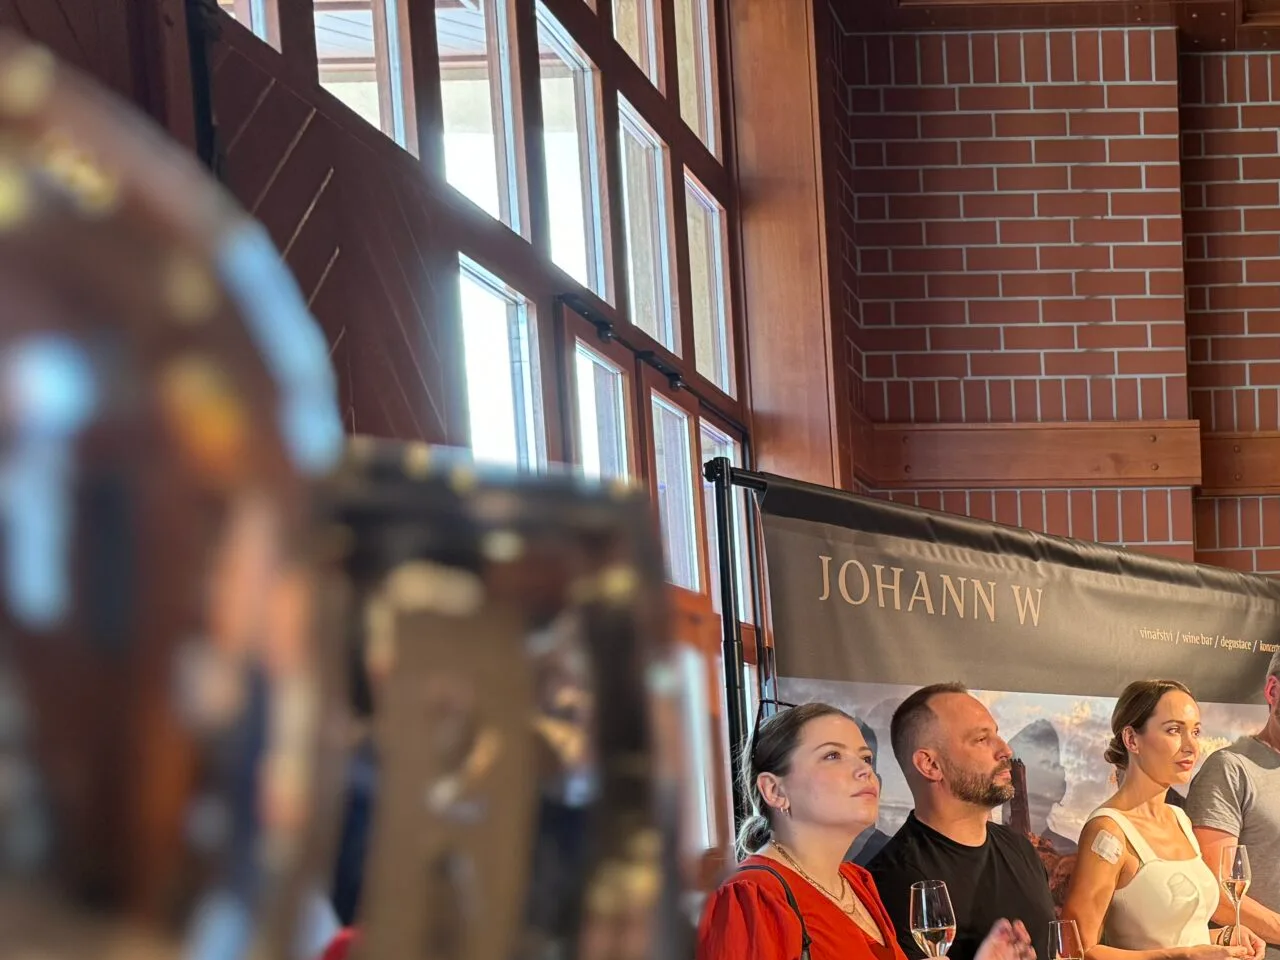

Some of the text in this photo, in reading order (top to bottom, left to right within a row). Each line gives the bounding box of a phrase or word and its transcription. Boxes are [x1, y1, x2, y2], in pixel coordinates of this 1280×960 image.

[818, 555, 1043, 627] JOHANN W
[1182, 631, 1200, 645] wine
[1200, 633, 1213, 646] bar
[1220, 637, 1252, 651] degustace
[1260, 640, 1280, 653] koncert
